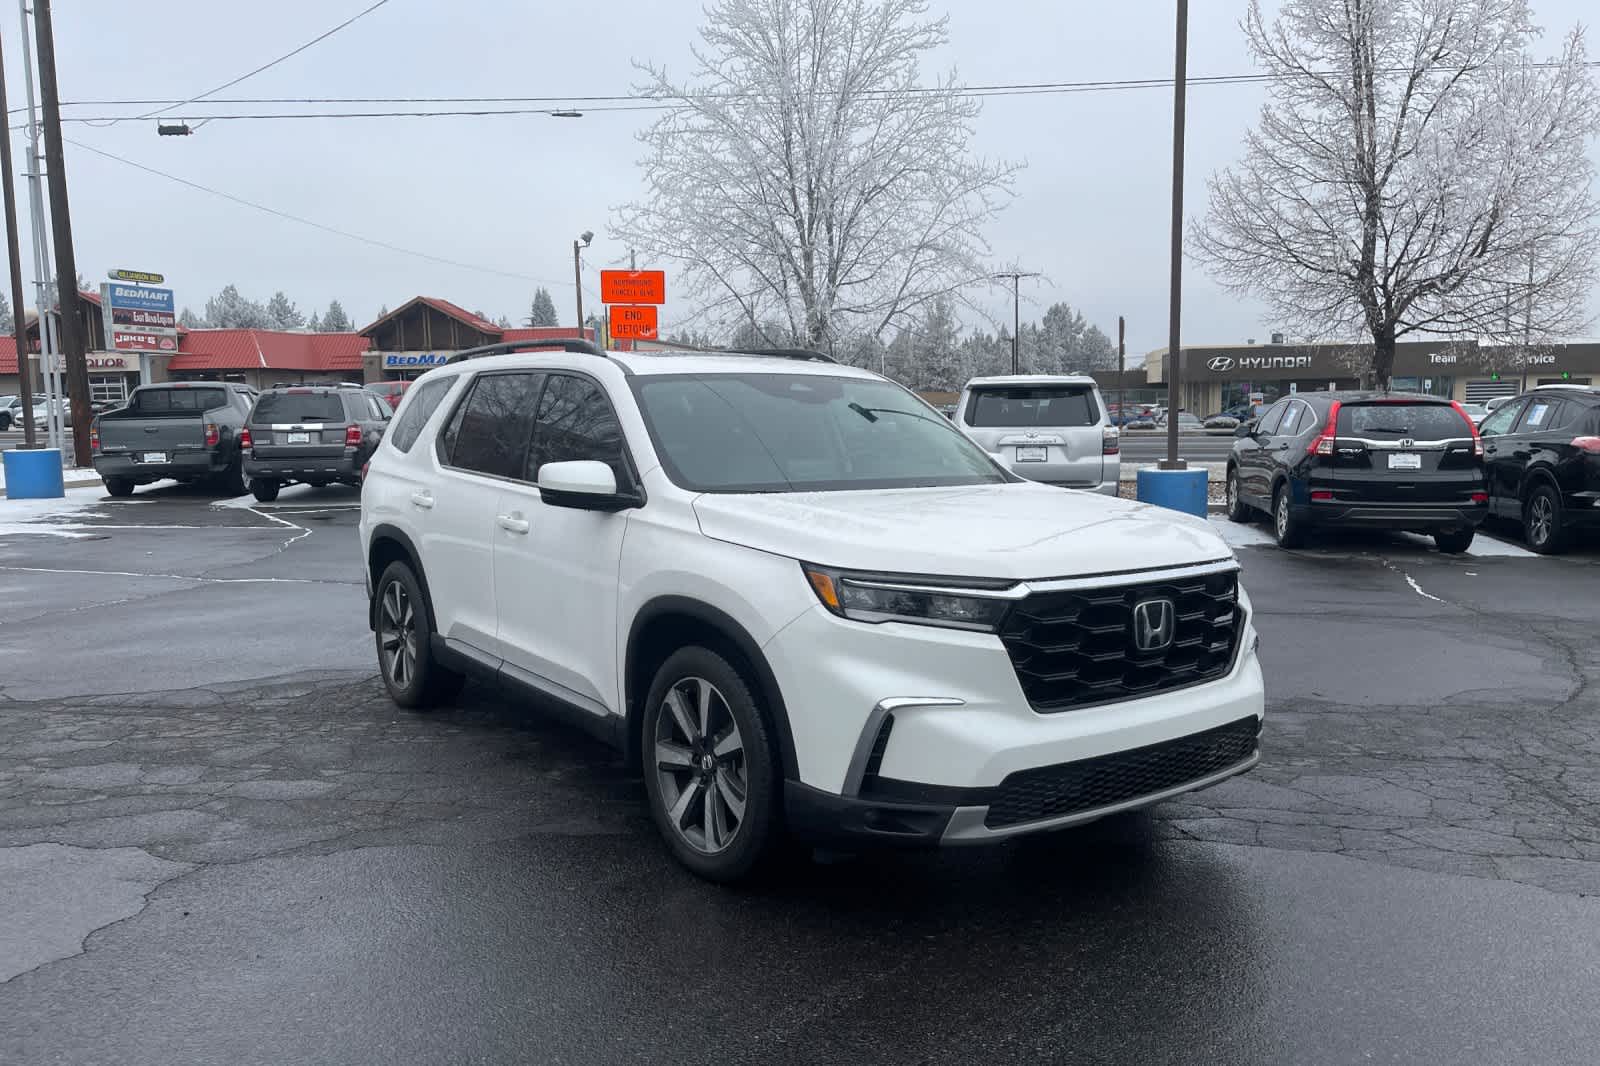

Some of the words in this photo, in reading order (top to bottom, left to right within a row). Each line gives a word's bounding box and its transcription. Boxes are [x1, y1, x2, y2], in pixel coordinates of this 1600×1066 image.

[115, 287, 169, 301] BEDMART
[624, 310, 642, 321] END
[617, 323, 651, 335] DETOUR
[86, 358, 125, 369] QUOR
[386, 354, 448, 366] BEDMA
[1239, 356, 1312, 369] HYUNDAI
[1428, 353, 1457, 364] Team
[1515, 353, 1556, 364] Srvice
